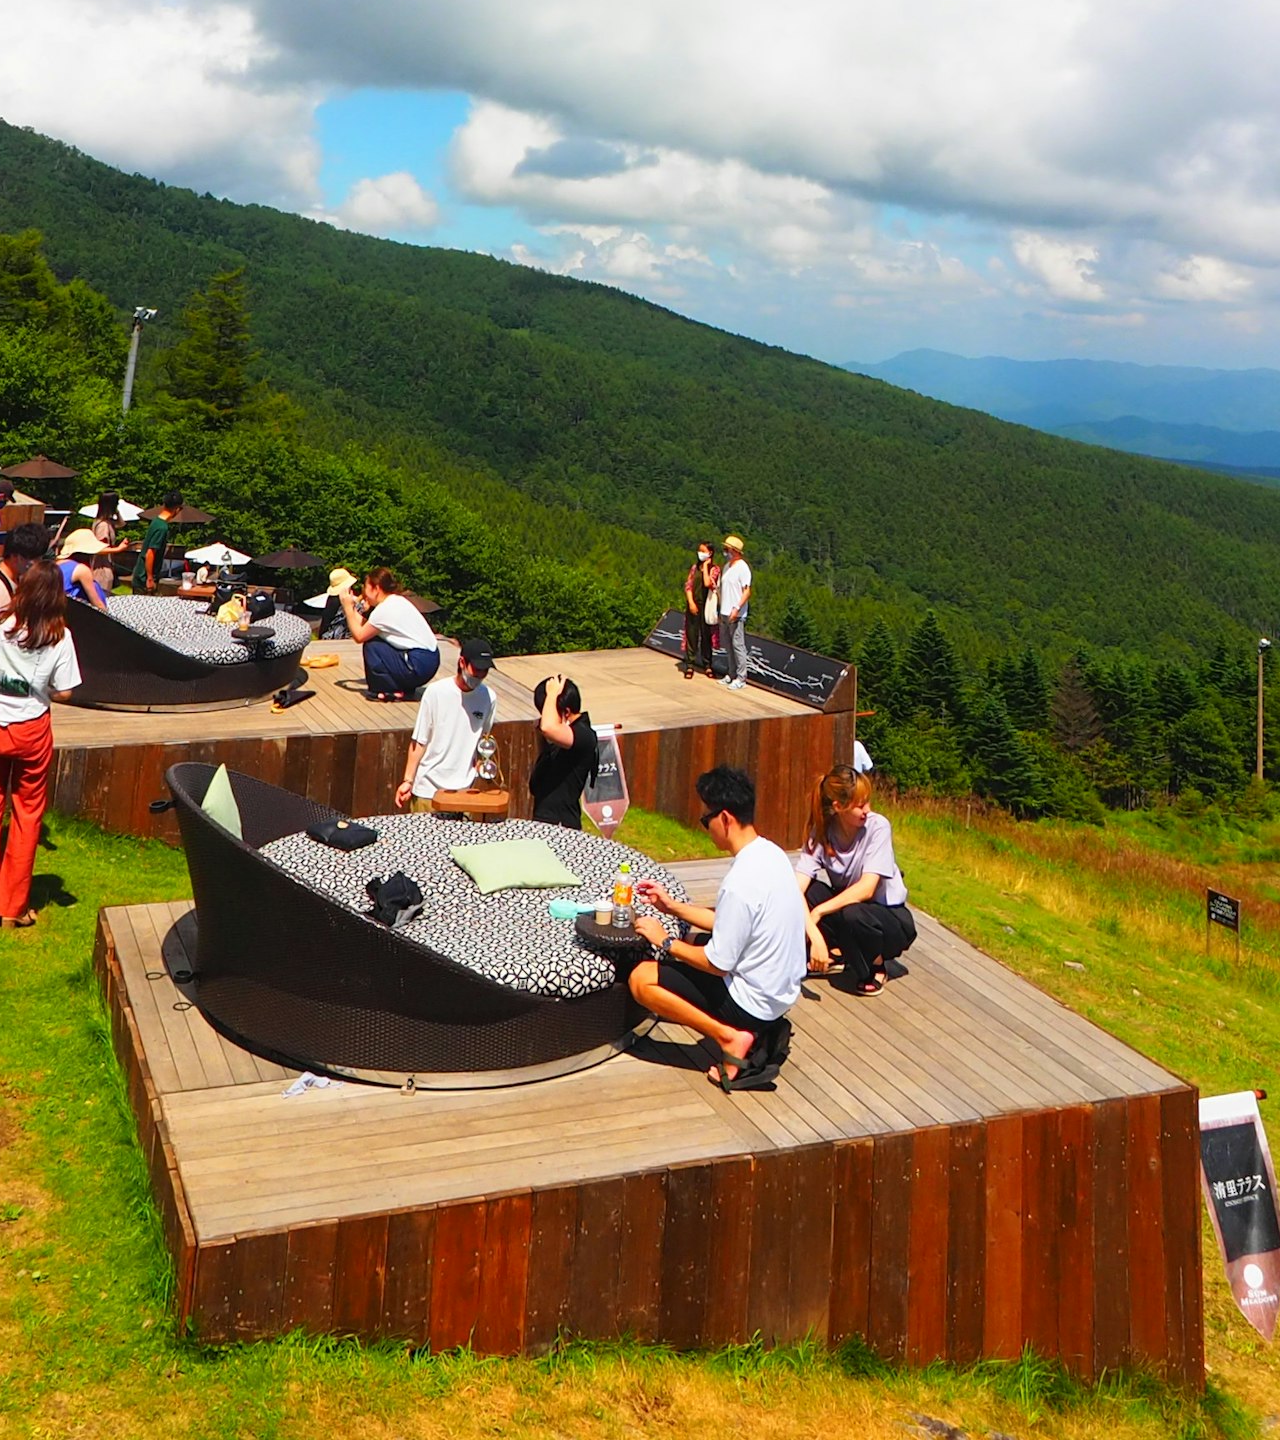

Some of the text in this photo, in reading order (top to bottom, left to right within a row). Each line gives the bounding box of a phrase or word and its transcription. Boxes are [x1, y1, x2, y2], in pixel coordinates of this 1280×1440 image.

[1213, 1174, 1266, 1200] 清里テラス
